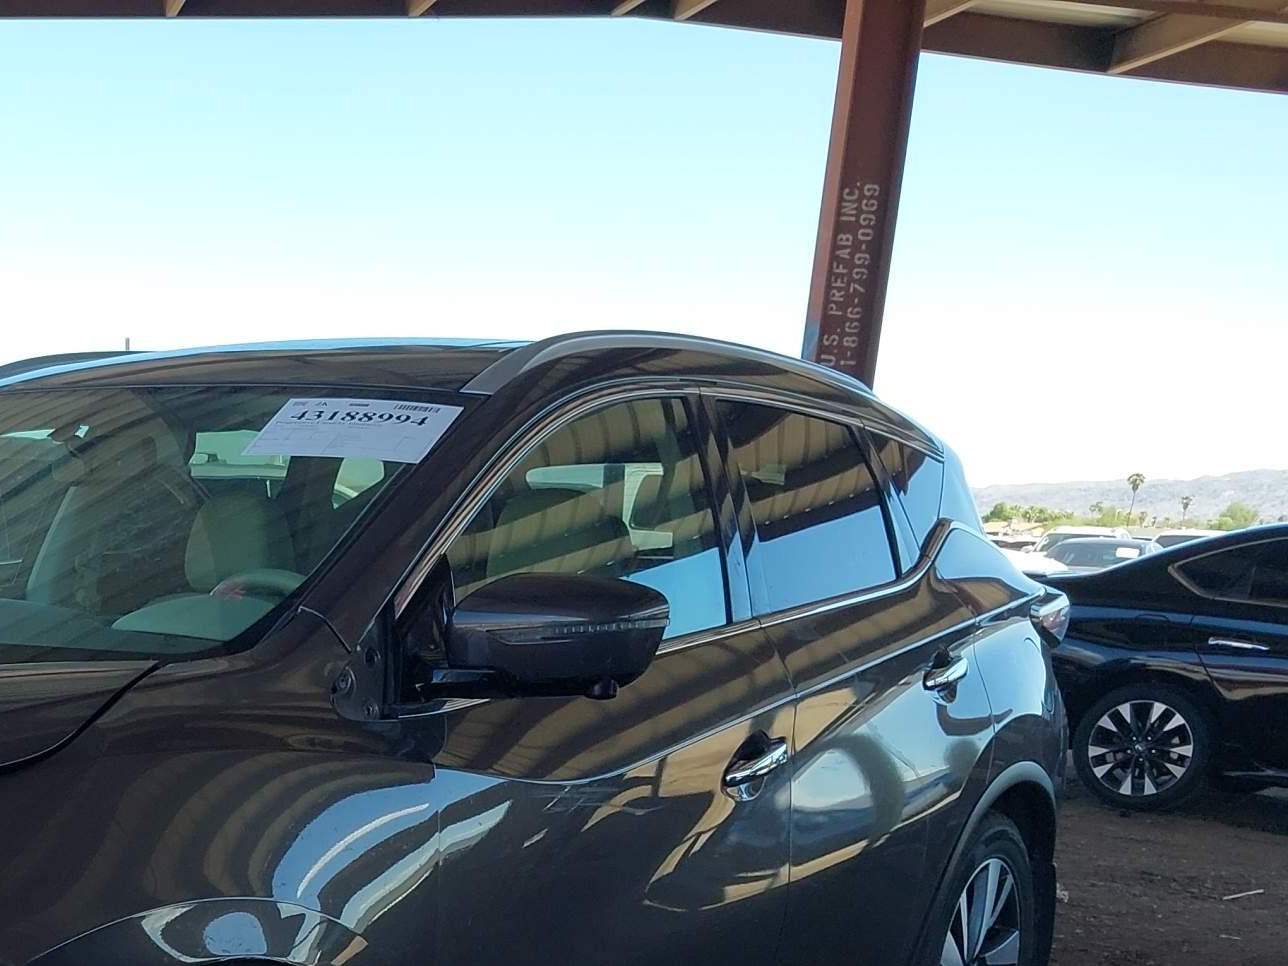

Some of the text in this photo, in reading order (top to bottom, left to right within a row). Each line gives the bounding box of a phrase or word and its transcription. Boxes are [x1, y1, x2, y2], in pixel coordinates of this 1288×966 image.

[820, 182, 861, 366] U.S. PREFAB INC.
[840, 183, 880, 366] 1-866-799-0969
[290, 410, 429, 427] 43188994
